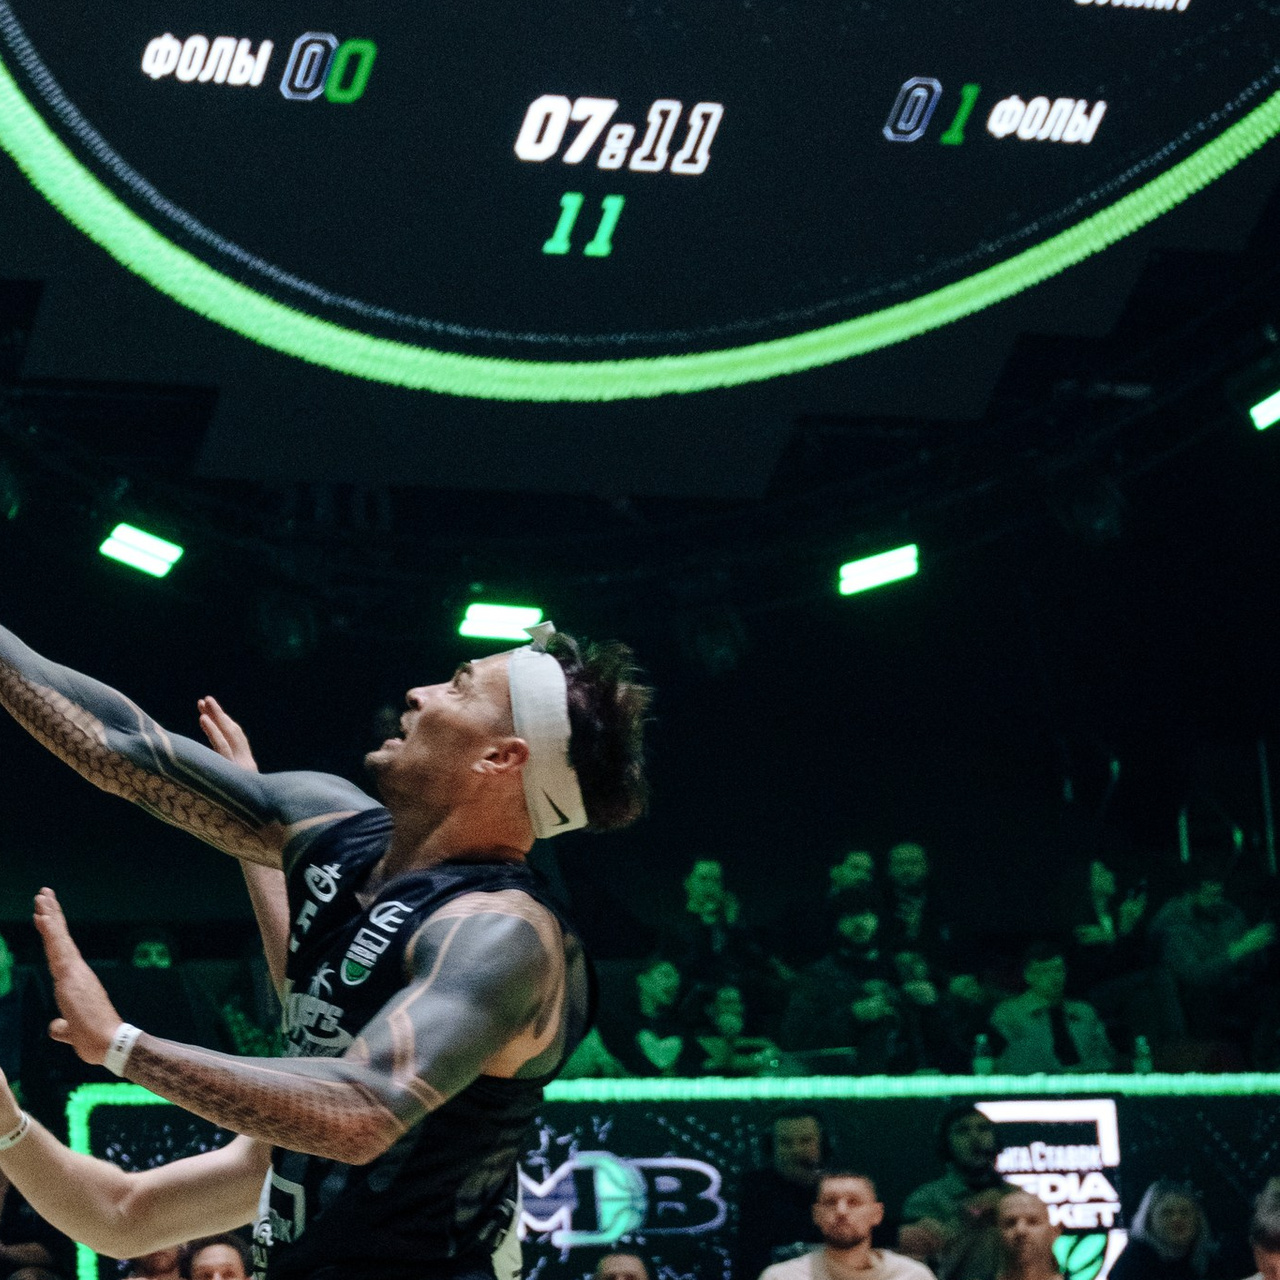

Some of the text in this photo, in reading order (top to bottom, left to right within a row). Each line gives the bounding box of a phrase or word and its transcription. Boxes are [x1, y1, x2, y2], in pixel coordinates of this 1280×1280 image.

[141, 32, 274, 87] ФОЛЫ
[986, 95, 1107, 144] ФОЛЫ
[542, 191, 626, 258] 11
